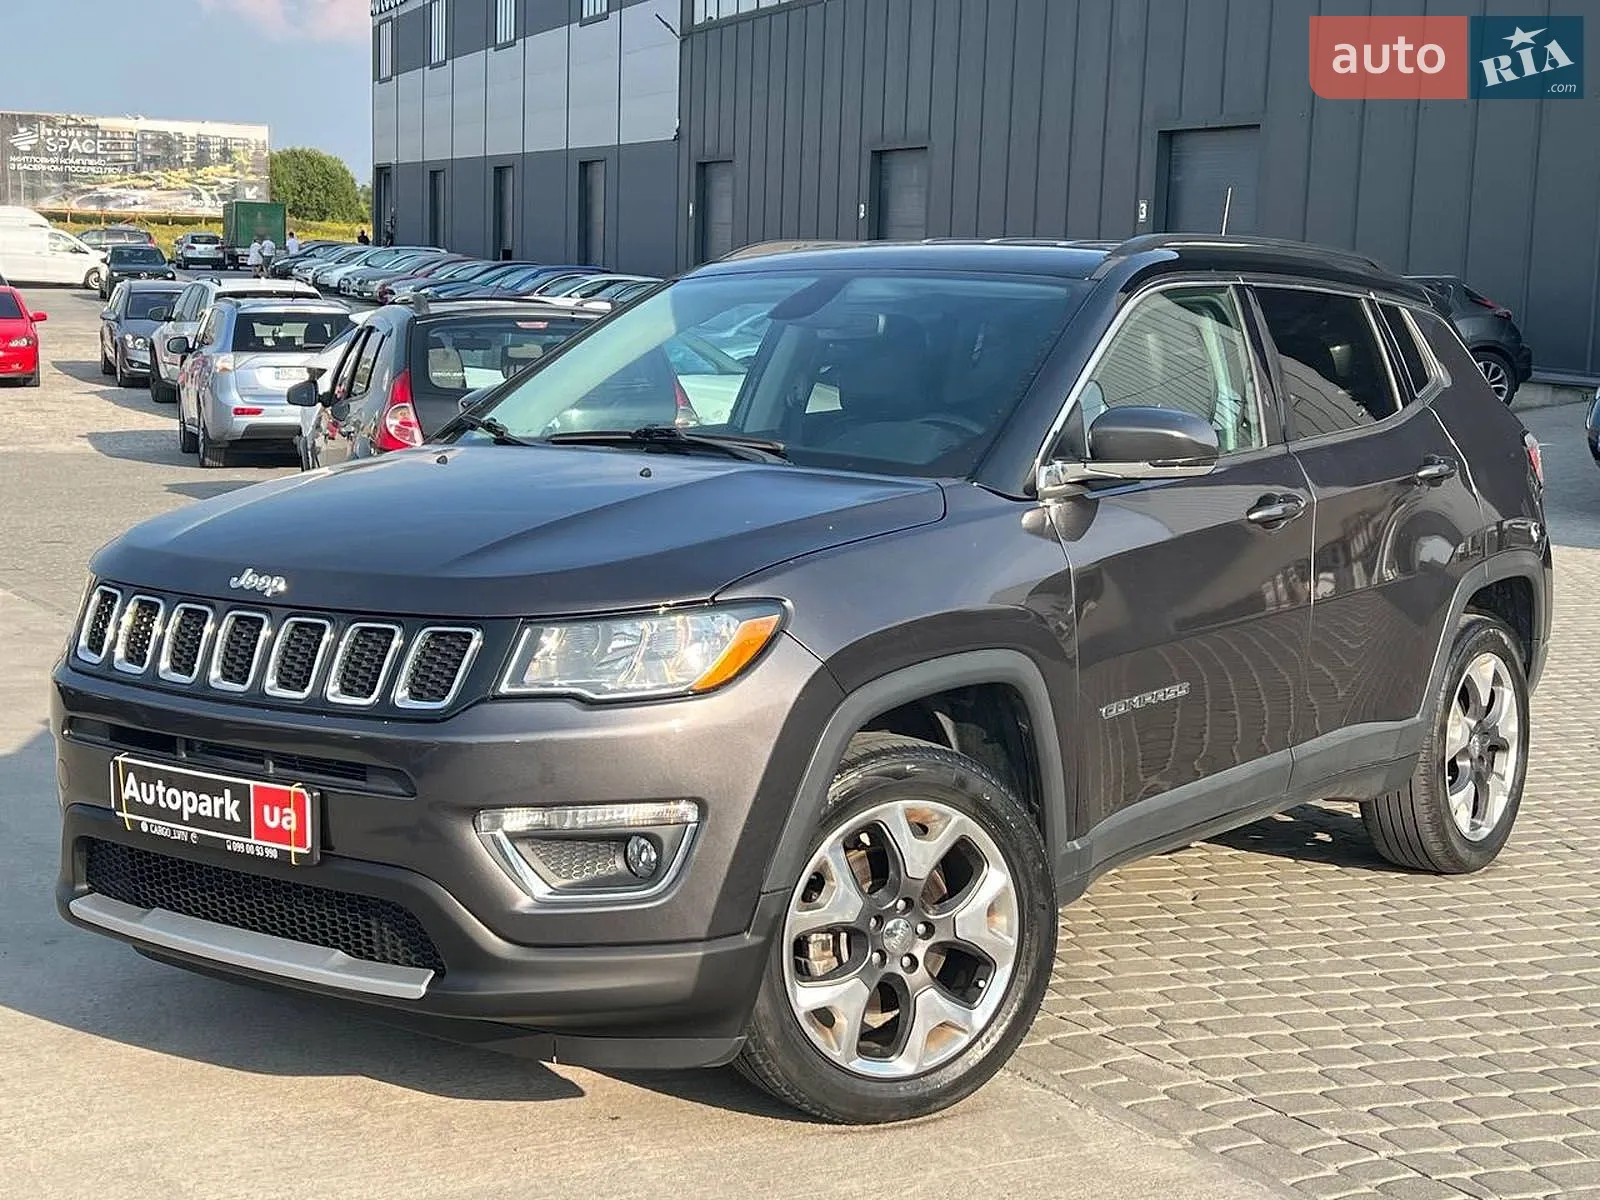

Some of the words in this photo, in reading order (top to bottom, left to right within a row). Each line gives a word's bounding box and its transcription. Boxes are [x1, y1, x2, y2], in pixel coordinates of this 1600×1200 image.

[45, 137, 108, 155] SPACE
[1100, 681, 1191, 720] COMPASS
[124, 771, 241, 822] Autopark
[262, 804, 297, 831] ua
